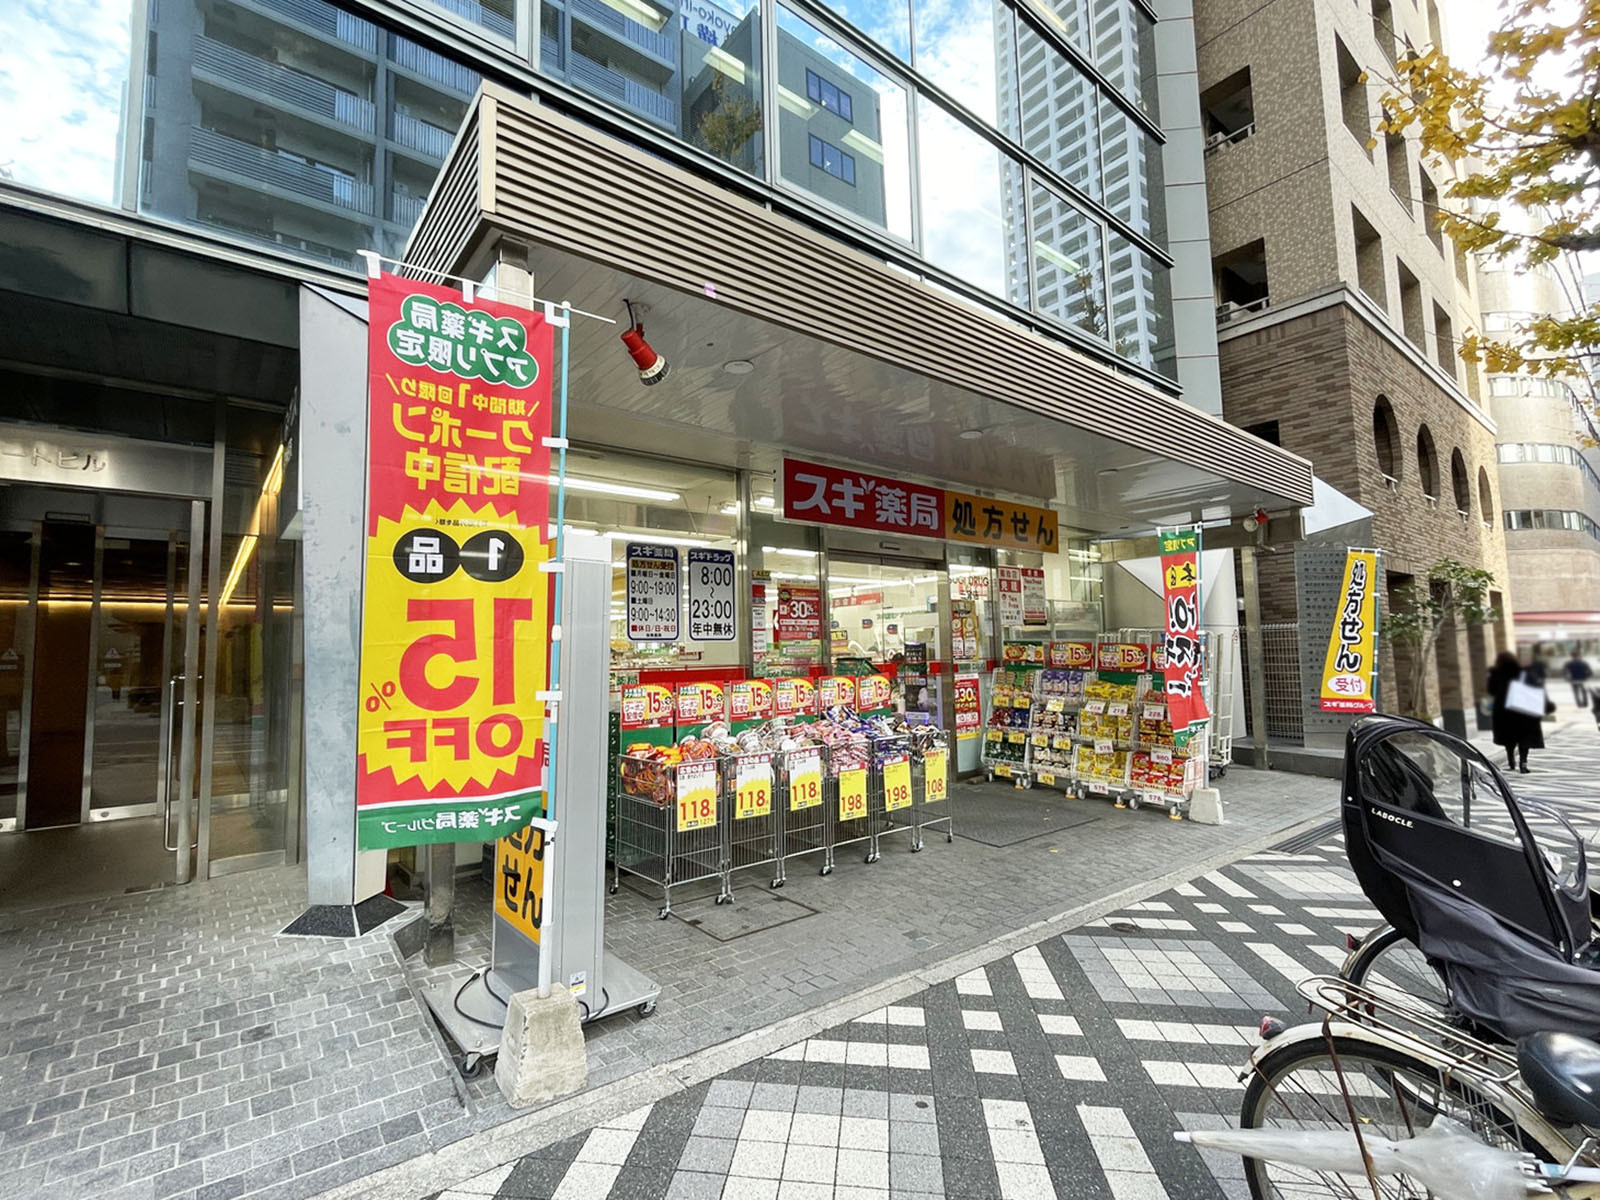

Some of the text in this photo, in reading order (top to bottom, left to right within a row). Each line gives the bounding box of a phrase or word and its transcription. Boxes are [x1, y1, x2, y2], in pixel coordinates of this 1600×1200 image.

[792, 472, 1054, 547] スギ薬局 処方せん
[690, 551, 732, 562] スギドラッグ
[700, 566, 732, 587] 8:00
[692, 599, 732, 619] 23:00
[1335, 559, 1367, 672] 処方せん
[692, 622, 733, 637] 年中無休
[1335, 677, 1364, 693] 受付
[791, 781, 817, 802] 118
[886, 784, 908, 804] 198
[926, 778, 943, 795] 108
[680, 798, 710, 821] 118
[738, 789, 766, 810] 118
[841, 793, 862, 813] 198
[1371, 807, 1414, 829] LABOCLE
[502, 853, 544, 930] せん
